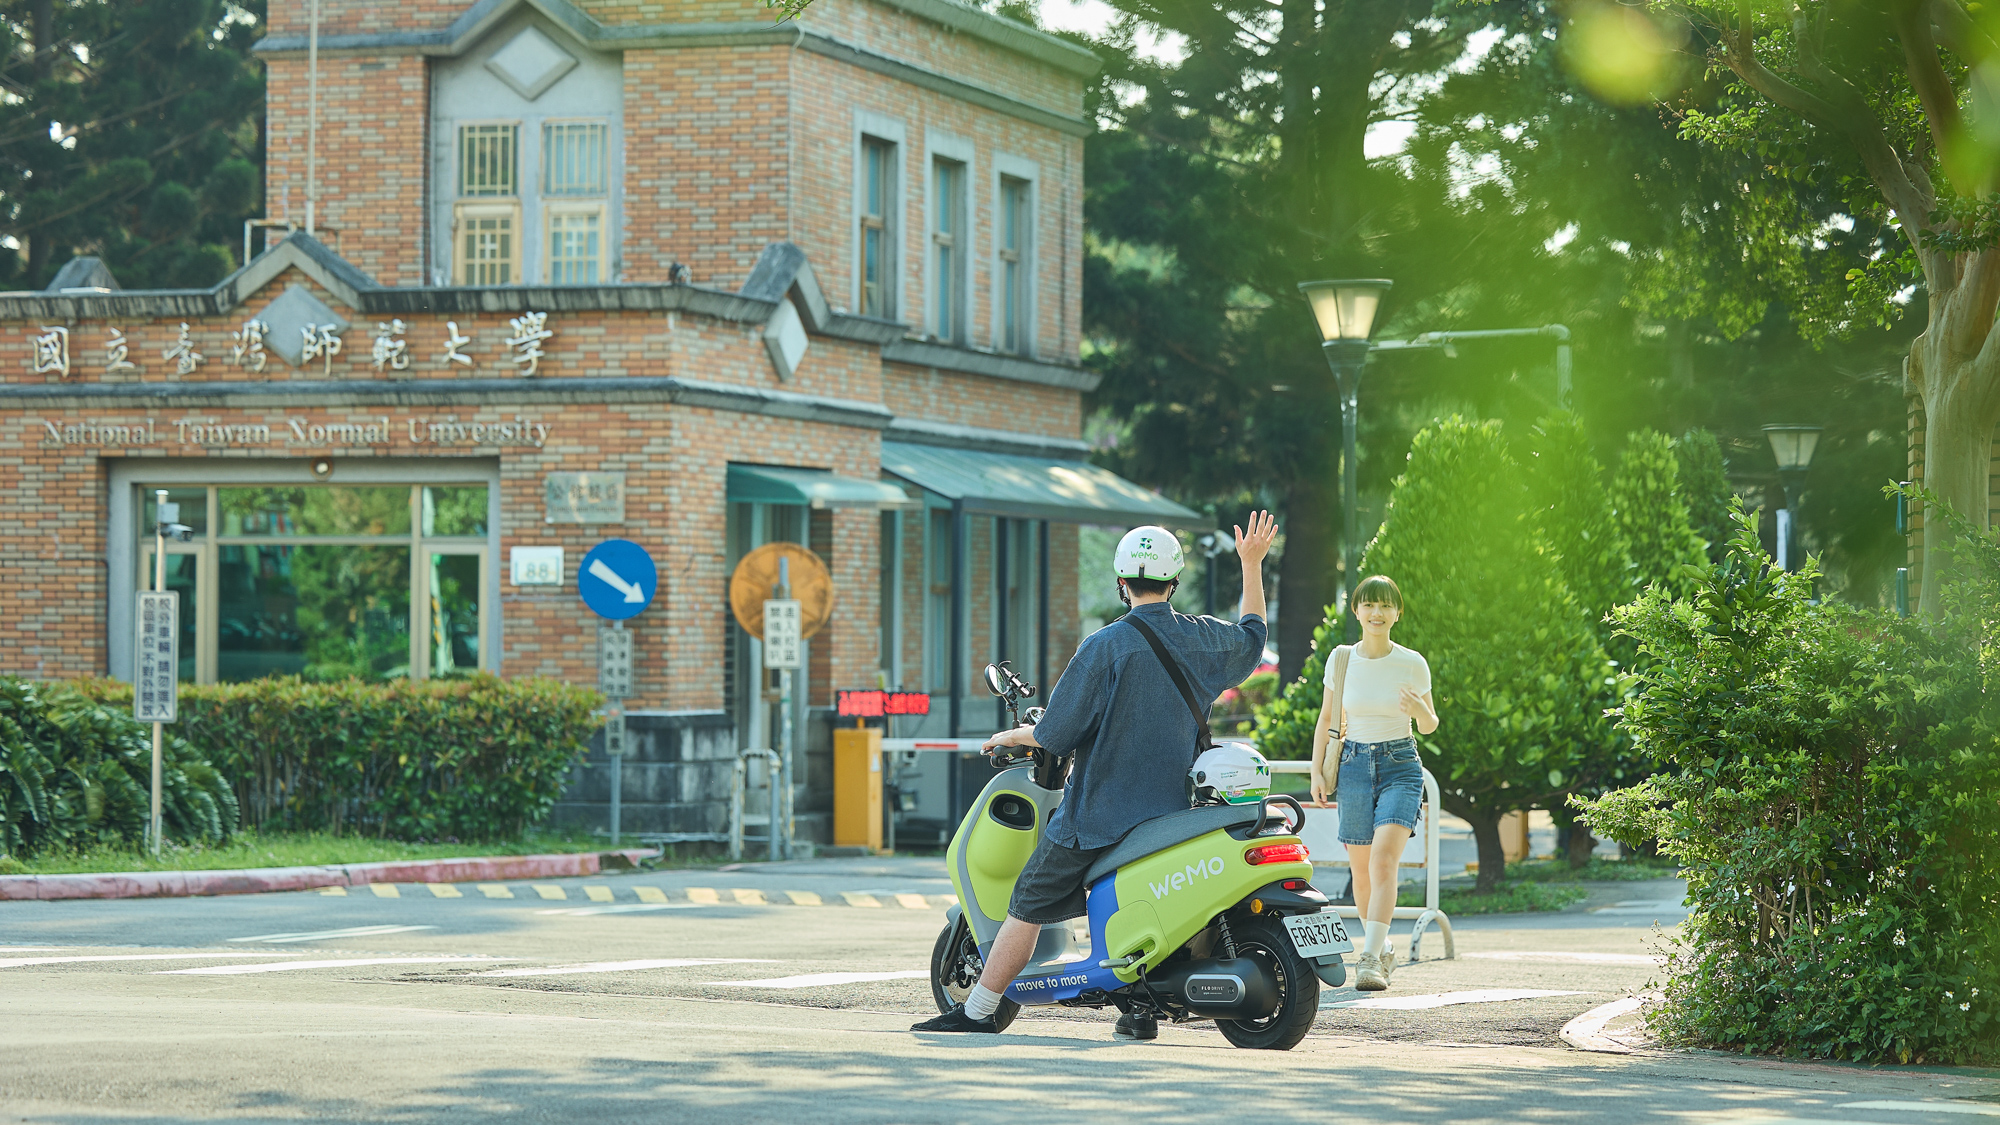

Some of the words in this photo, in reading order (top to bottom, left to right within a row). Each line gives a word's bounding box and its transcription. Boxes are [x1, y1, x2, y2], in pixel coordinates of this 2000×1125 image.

[43, 417, 155, 445] National
[172, 417, 271, 445] Taiwan
[287, 415, 390, 444] Normal
[408, 414, 552, 448] University
[526, 562, 549, 580] 88
[1015, 979, 1045, 992] move
[1046, 977, 1058, 988] to
[1060, 974, 1088, 987] more
